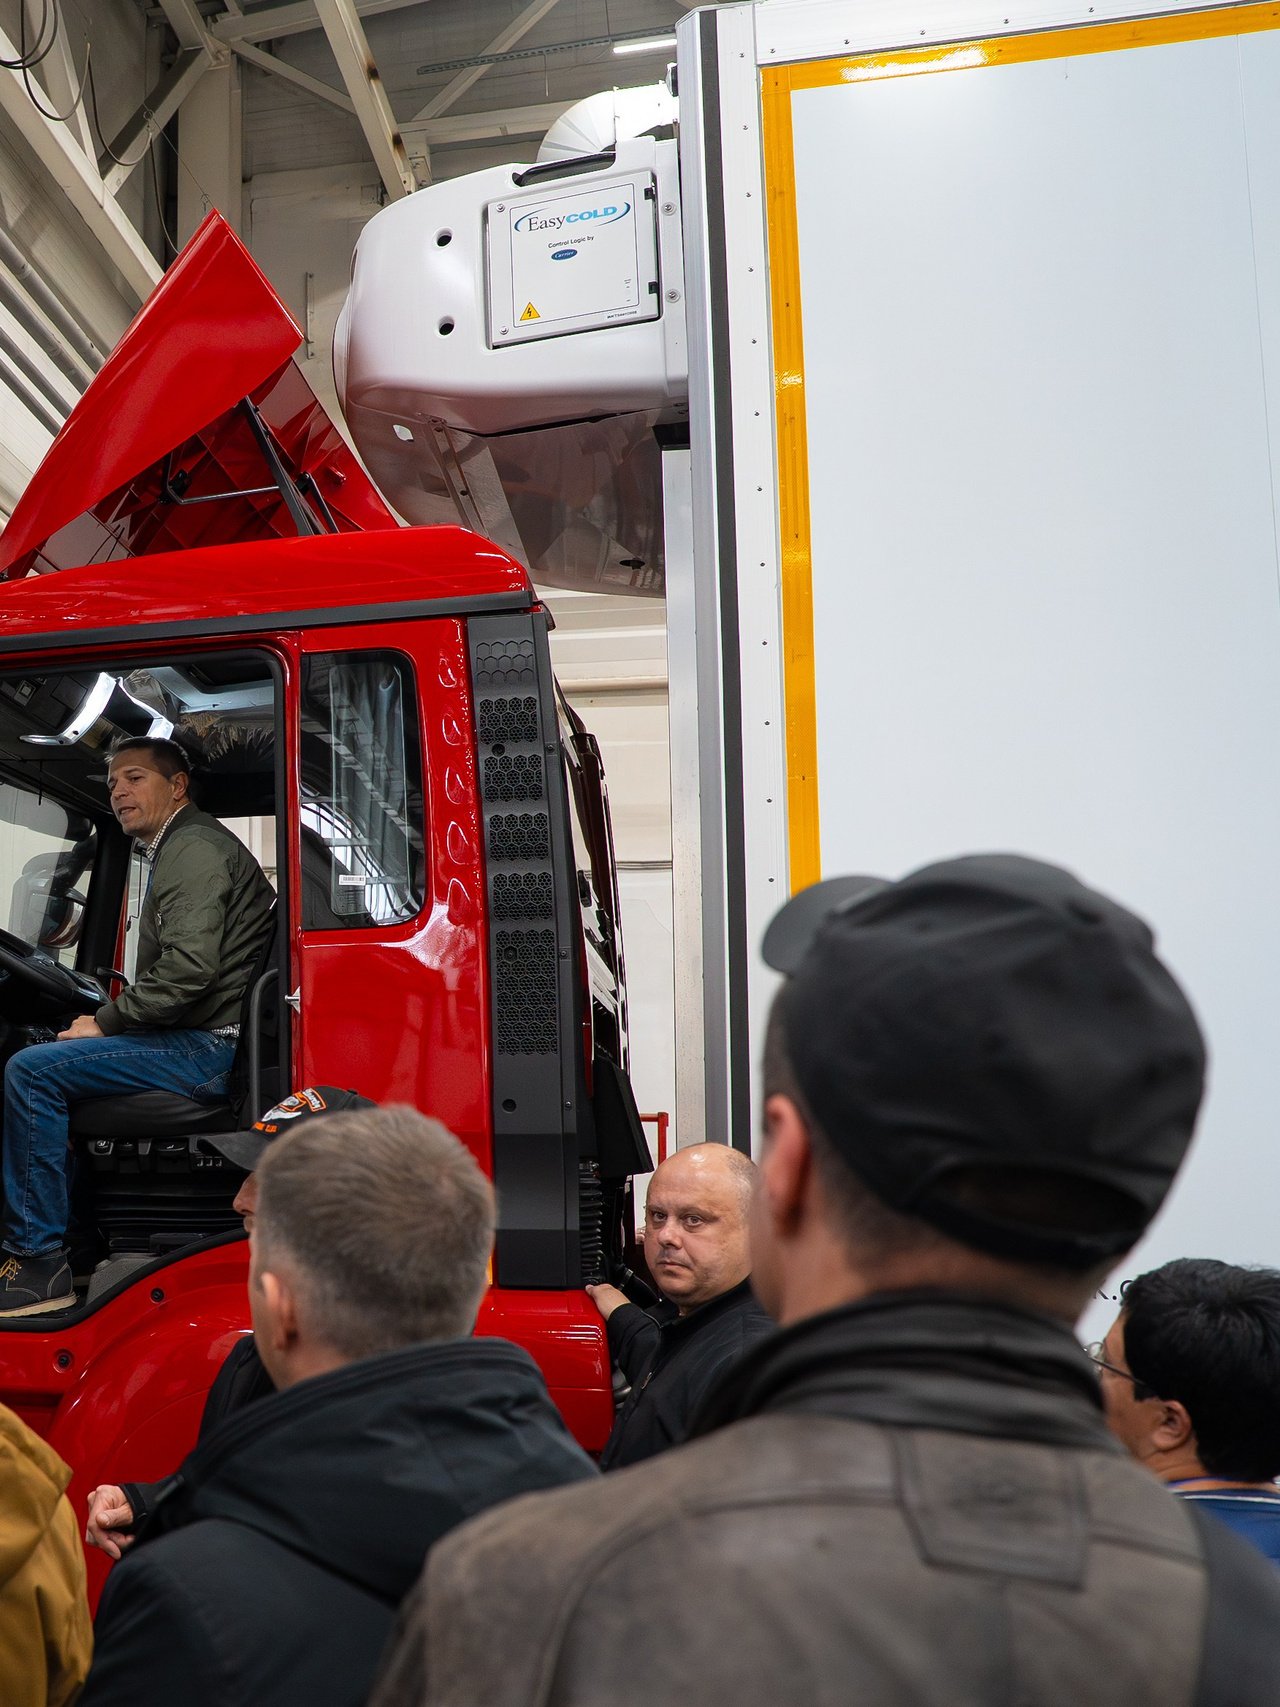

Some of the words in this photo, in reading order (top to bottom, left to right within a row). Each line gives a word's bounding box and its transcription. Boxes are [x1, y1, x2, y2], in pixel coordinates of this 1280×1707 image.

[528, 206, 618, 232] EasyCOLD
[548, 240, 569, 249] Control
[570, 237, 586, 245] Logic
[554, 250, 575, 259] Carrier
